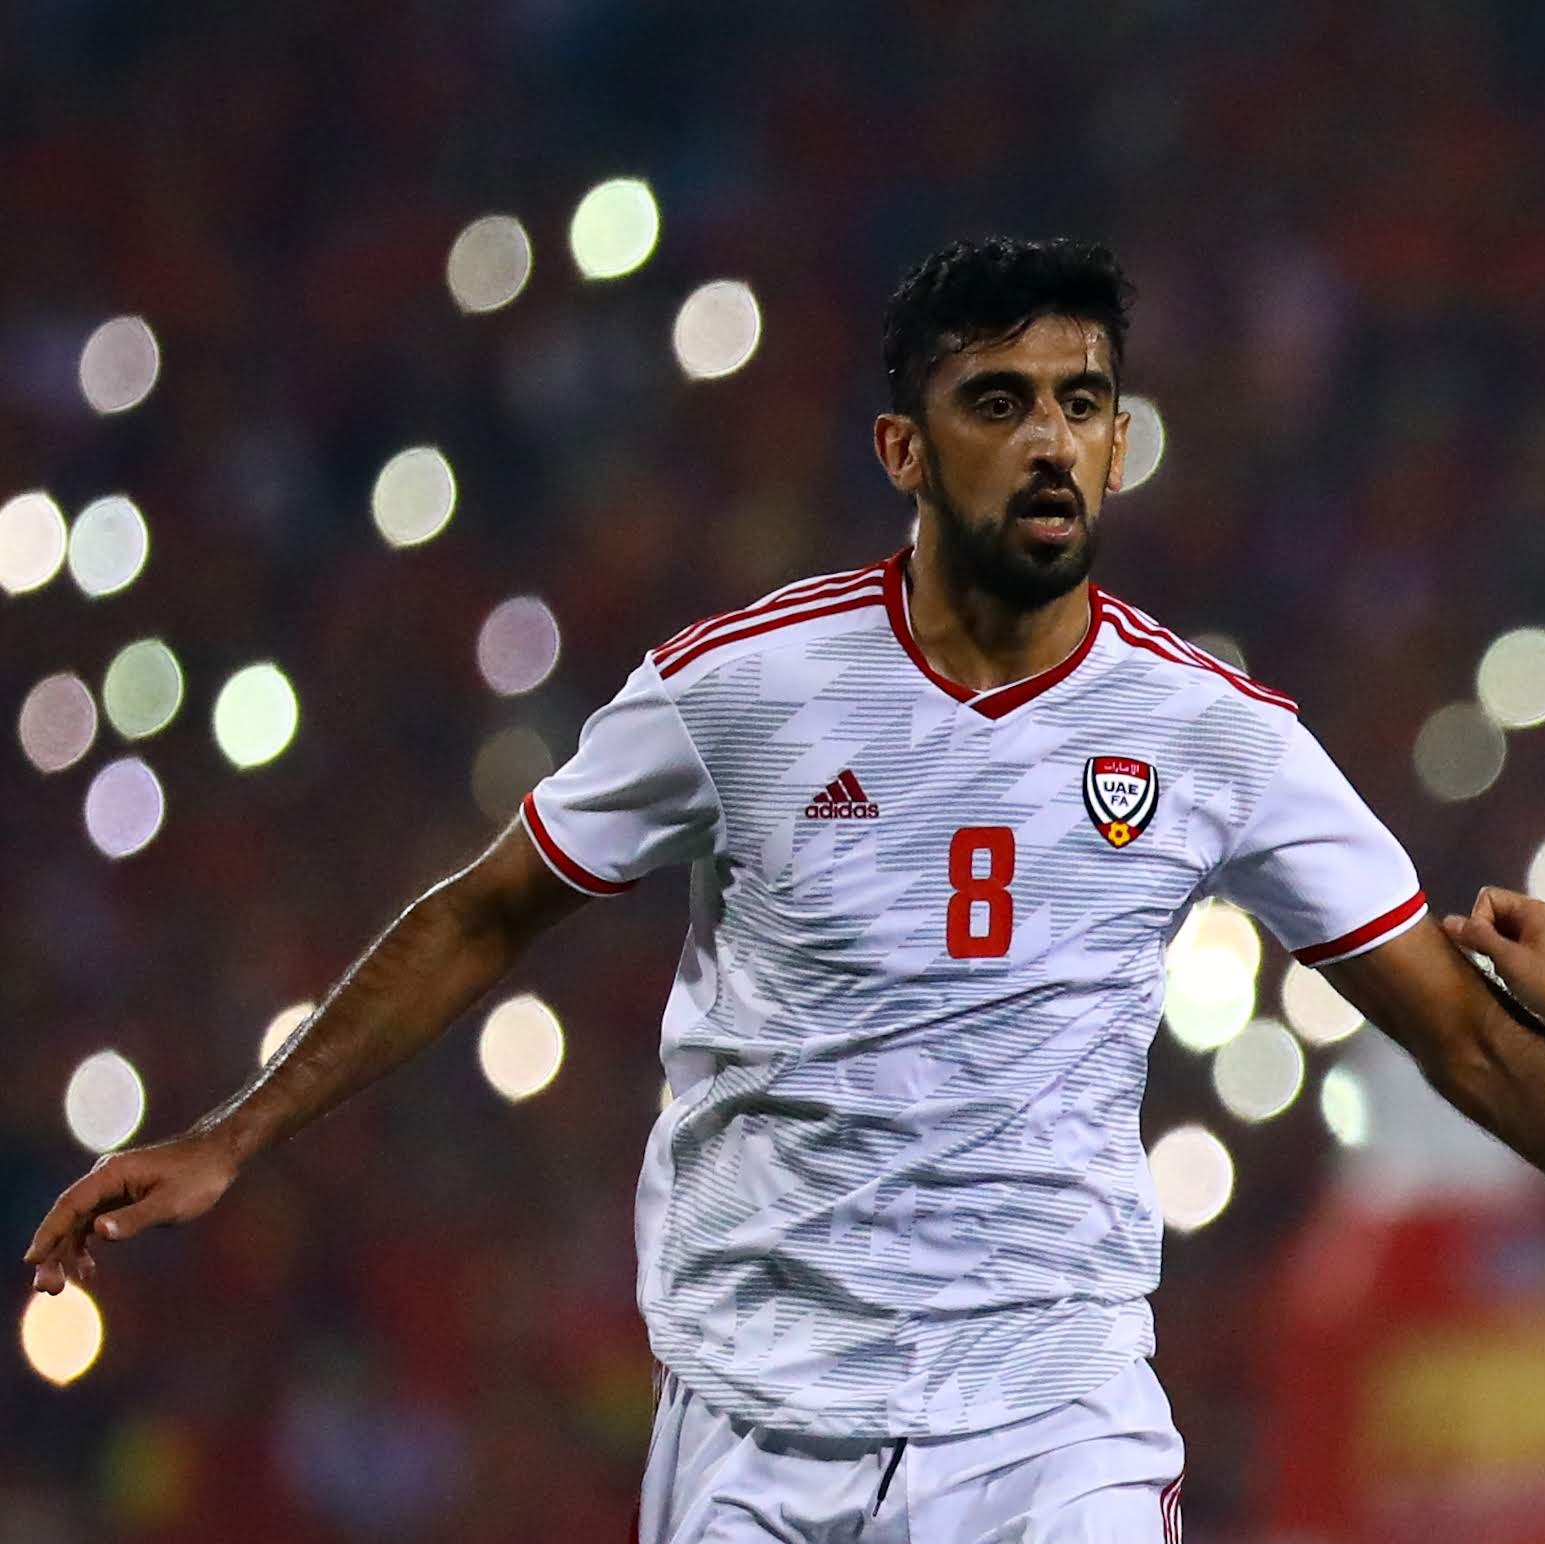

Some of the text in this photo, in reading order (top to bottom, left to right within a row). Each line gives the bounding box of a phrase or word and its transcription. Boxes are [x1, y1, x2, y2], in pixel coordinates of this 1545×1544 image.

[1103, 781, 1139, 796] UAE
[805, 800, 880, 819] adidas
[1110, 795, 1129, 807] FA
[946, 825, 1017, 959] 8
